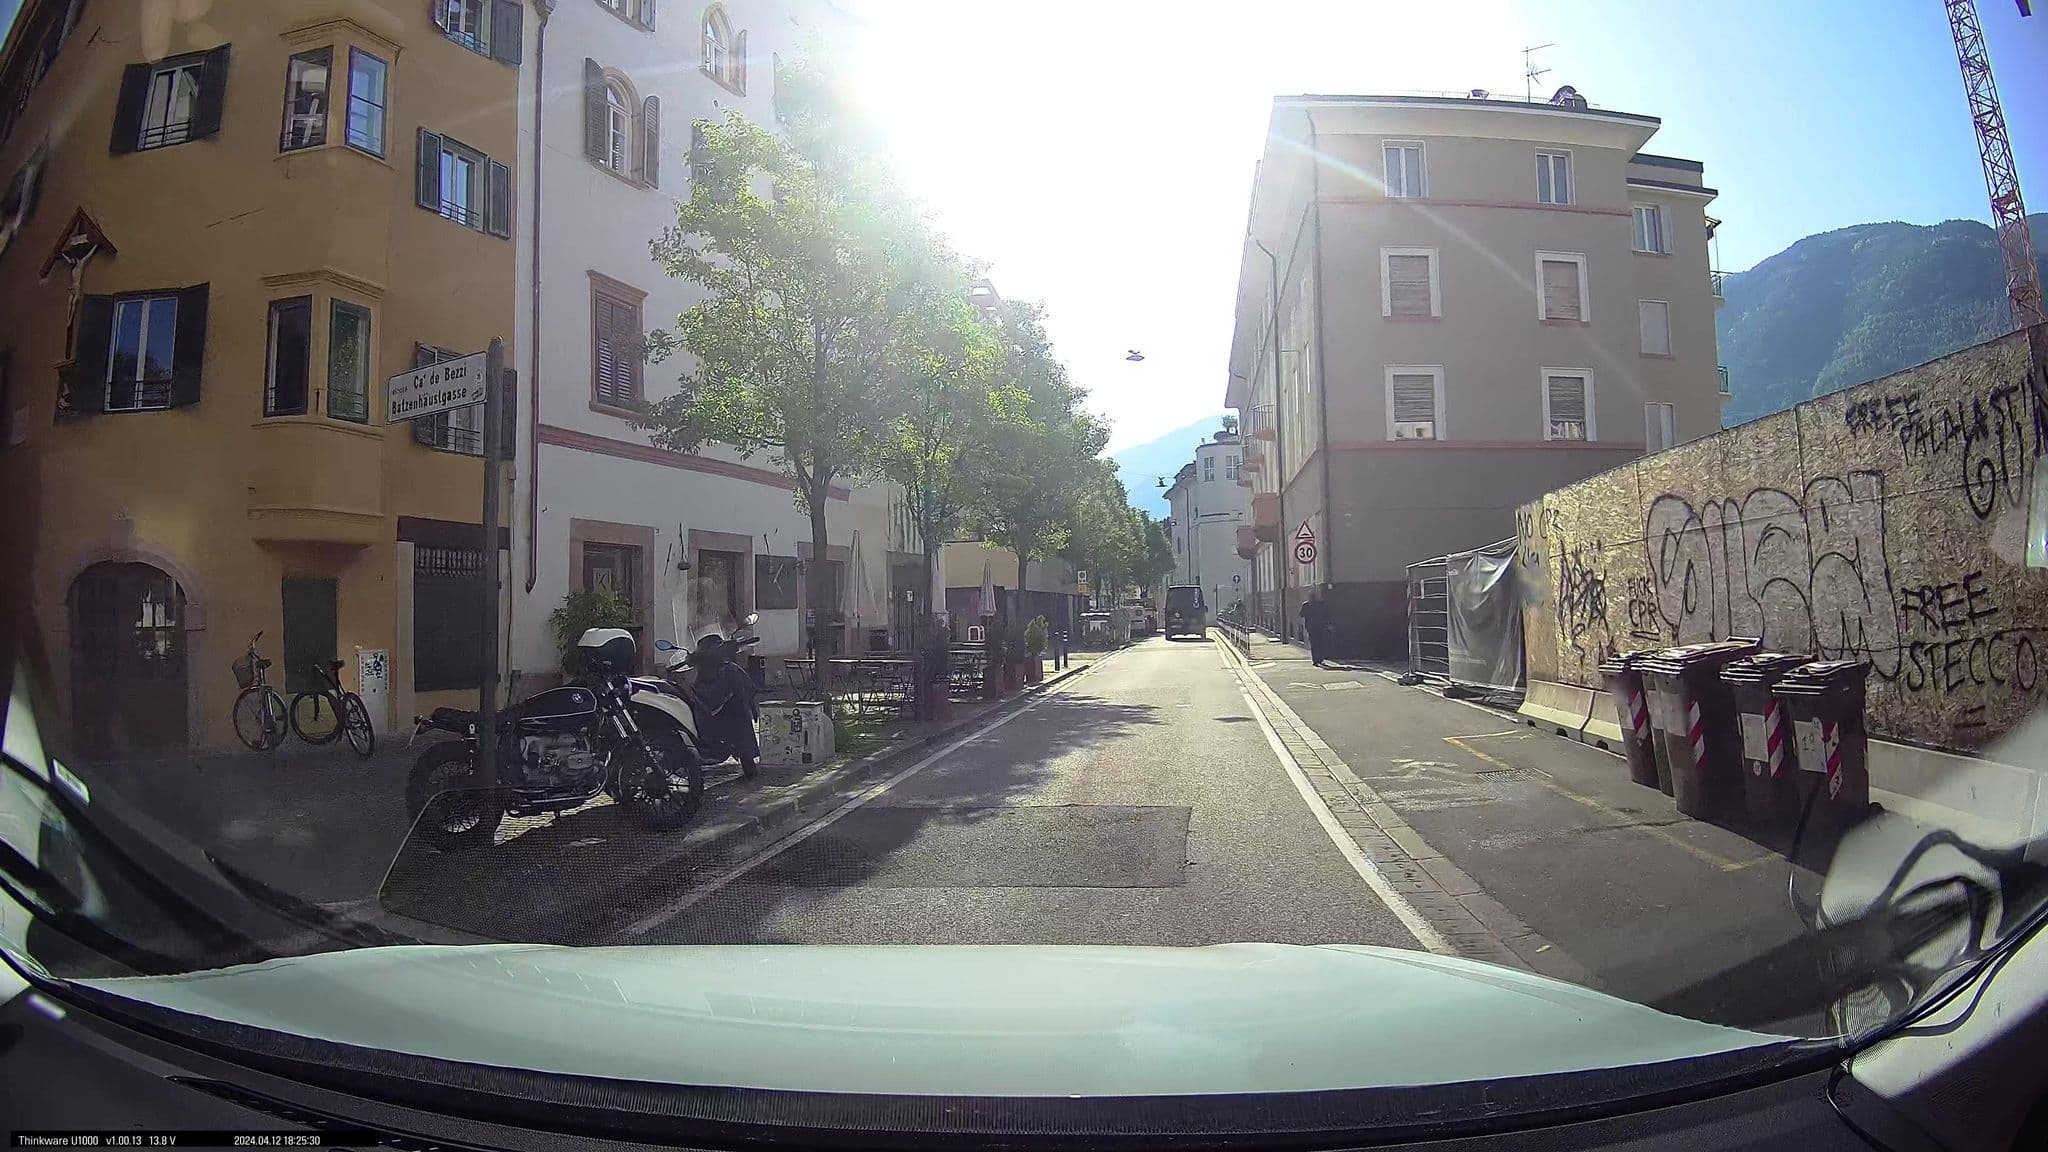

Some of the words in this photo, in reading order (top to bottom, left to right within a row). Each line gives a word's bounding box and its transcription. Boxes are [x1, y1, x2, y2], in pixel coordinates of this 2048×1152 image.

[430, 371, 440, 385] de
[444, 363, 467, 381] Bezzi
[391, 387, 467, 414] Batzenhäuslgasse
[1299, 547, 1313, 558] 30
[1628, 598, 1661, 632] CPR
[1900, 570, 1998, 635] FREE
[1907, 630, 2038, 693] STECCO
